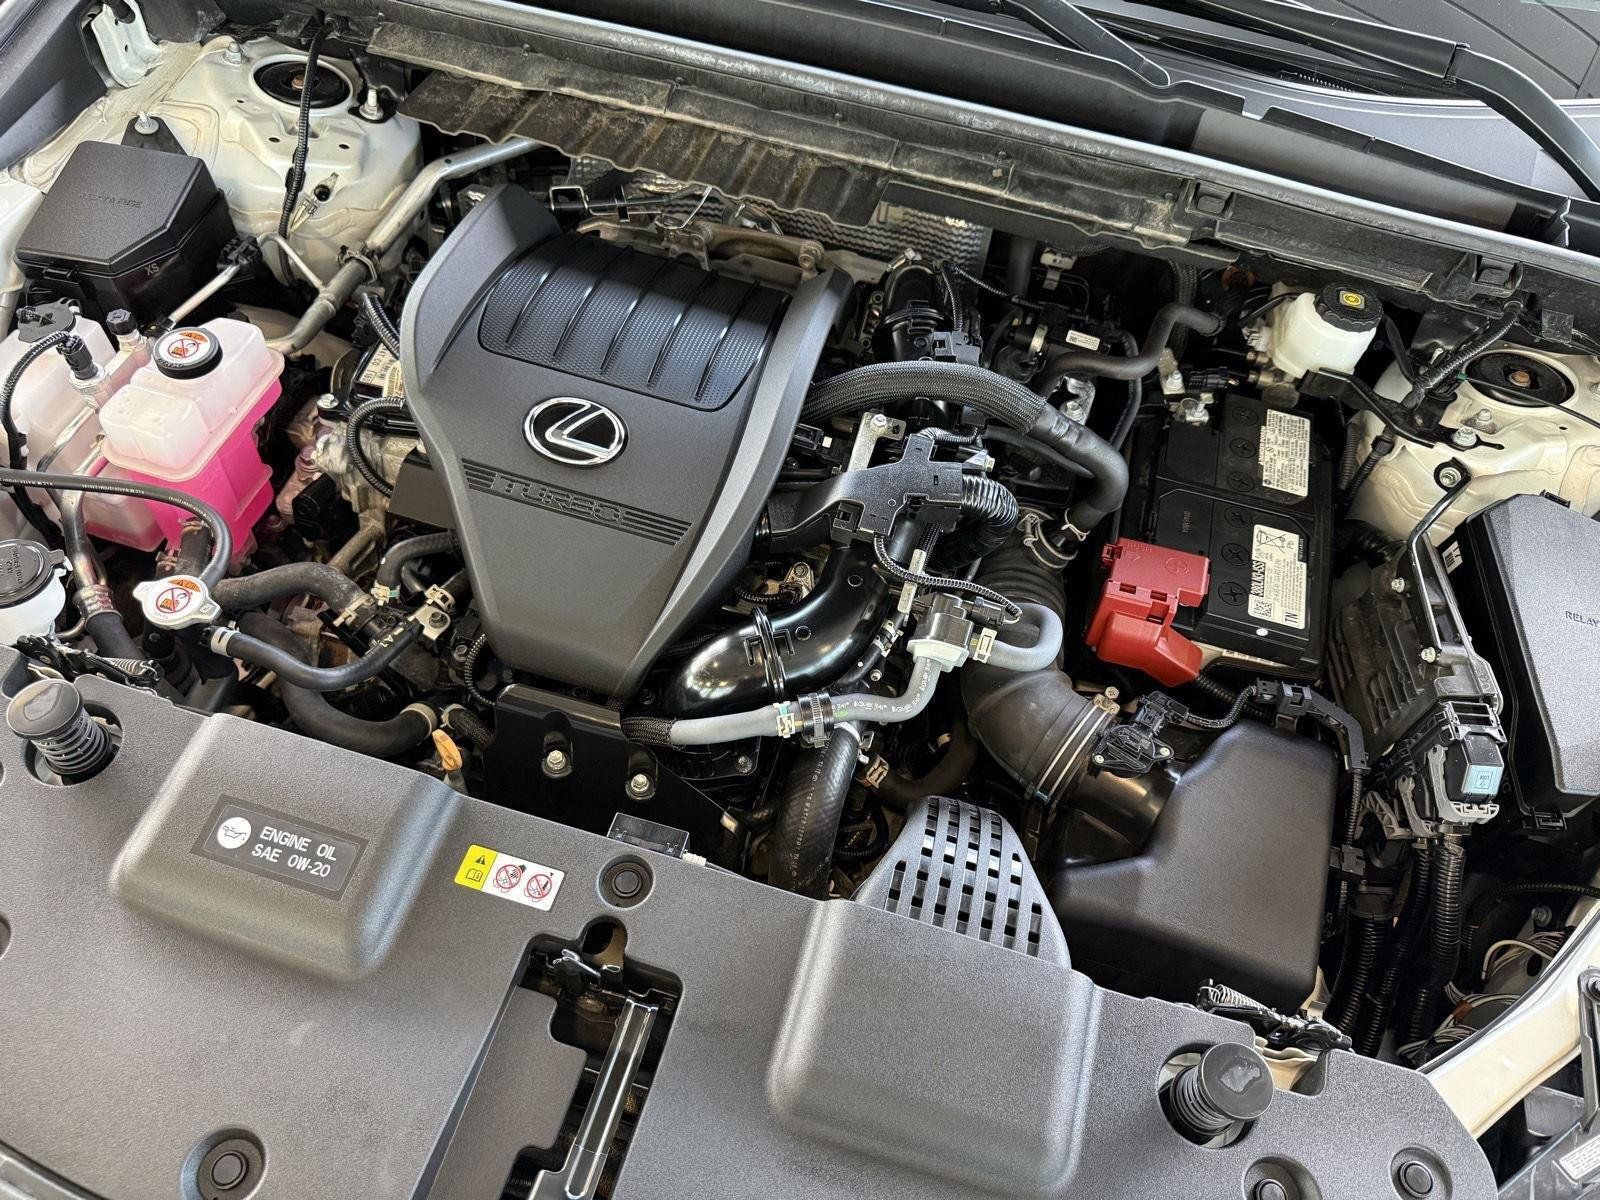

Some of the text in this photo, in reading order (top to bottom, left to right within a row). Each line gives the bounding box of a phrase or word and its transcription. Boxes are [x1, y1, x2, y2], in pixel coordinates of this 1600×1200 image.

[491, 472, 624, 527] TURBO
[1565, 610, 1600, 628] RELAY
[251, 843, 331, 878] SAE 0W-20
[259, 826, 337, 862] ENGINE OIL
